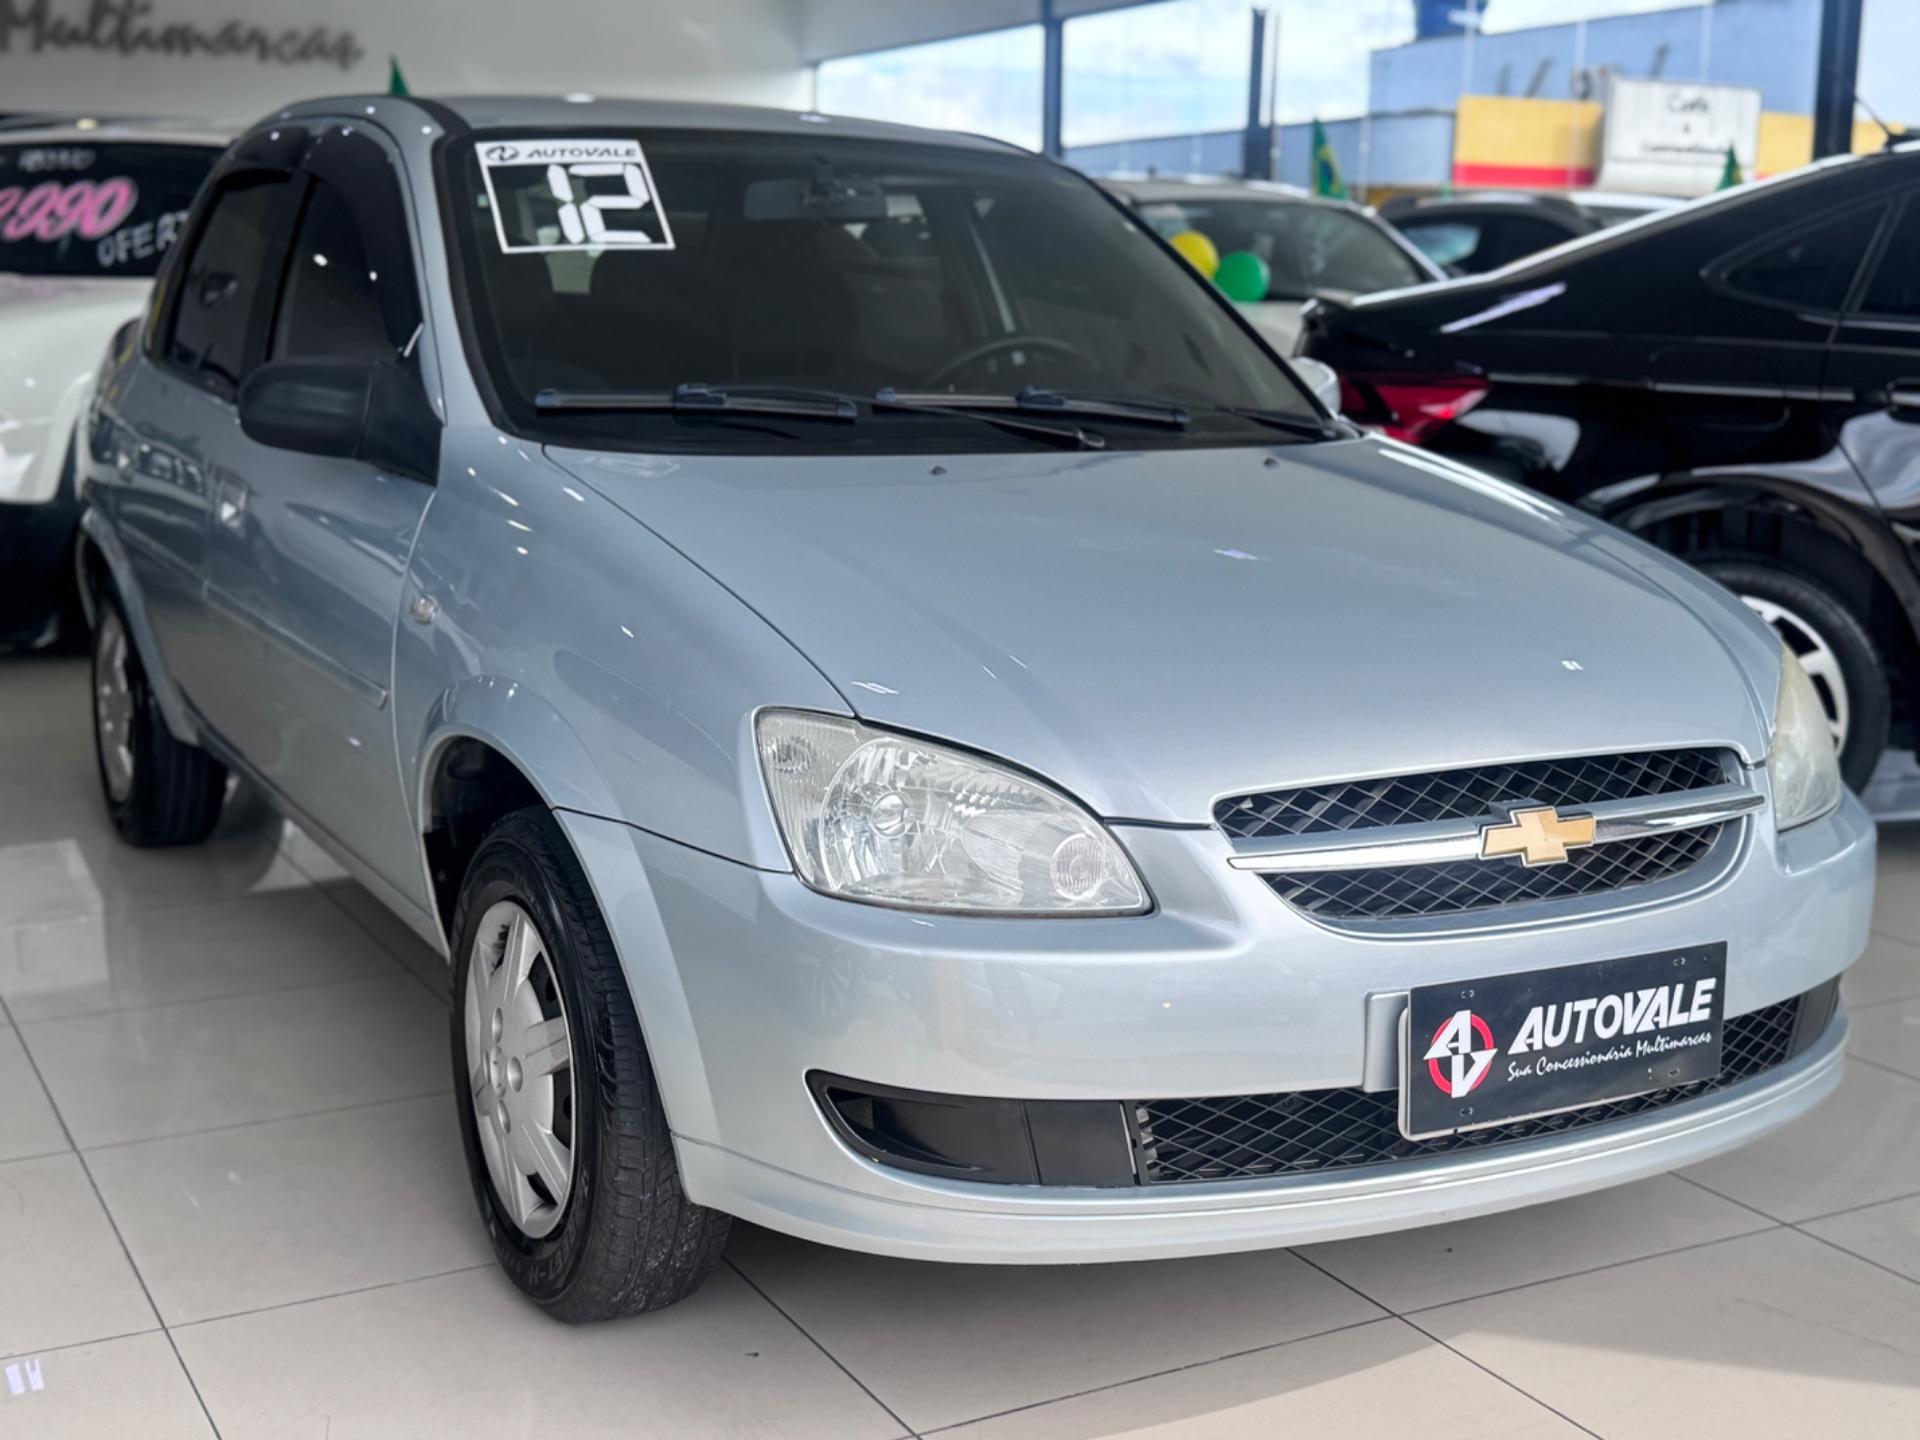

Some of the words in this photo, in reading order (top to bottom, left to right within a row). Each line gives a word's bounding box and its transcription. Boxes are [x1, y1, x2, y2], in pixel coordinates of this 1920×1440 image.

[526, 147, 636, 159] AUTOVALE
[547, 163, 652, 245] 12
[1507, 977, 1717, 1056] AUTOVALE
[1507, 1061, 1533, 1082] Sua
[1536, 1046, 1633, 1076] Concessionária
[1635, 1031, 1712, 1058] Multimarcas
